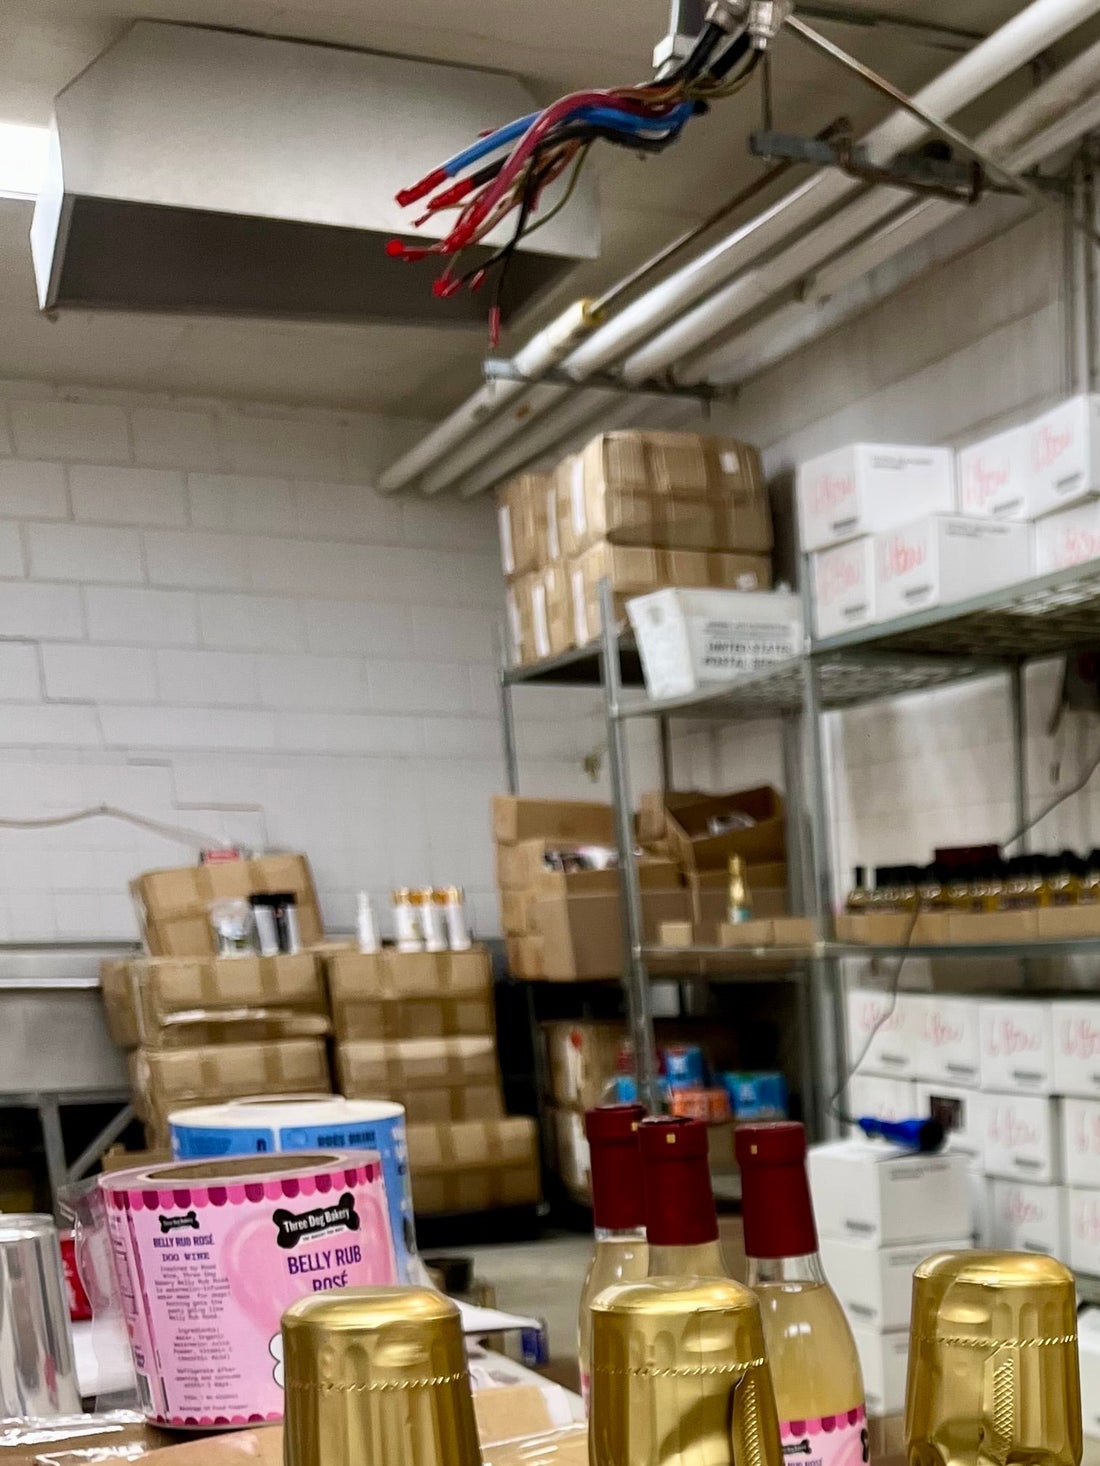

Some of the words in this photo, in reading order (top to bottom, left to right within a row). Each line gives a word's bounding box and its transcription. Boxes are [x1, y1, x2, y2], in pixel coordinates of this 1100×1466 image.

[283, 1220, 309, 1233] Three
[308, 1215, 326, 1227] Dog
[324, 1208, 350, 1223] Bakery
[287, 1250, 331, 1275] BELLY
[335, 1245, 362, 1267] RUB
[312, 1270, 348, 1292] ROSÉ
